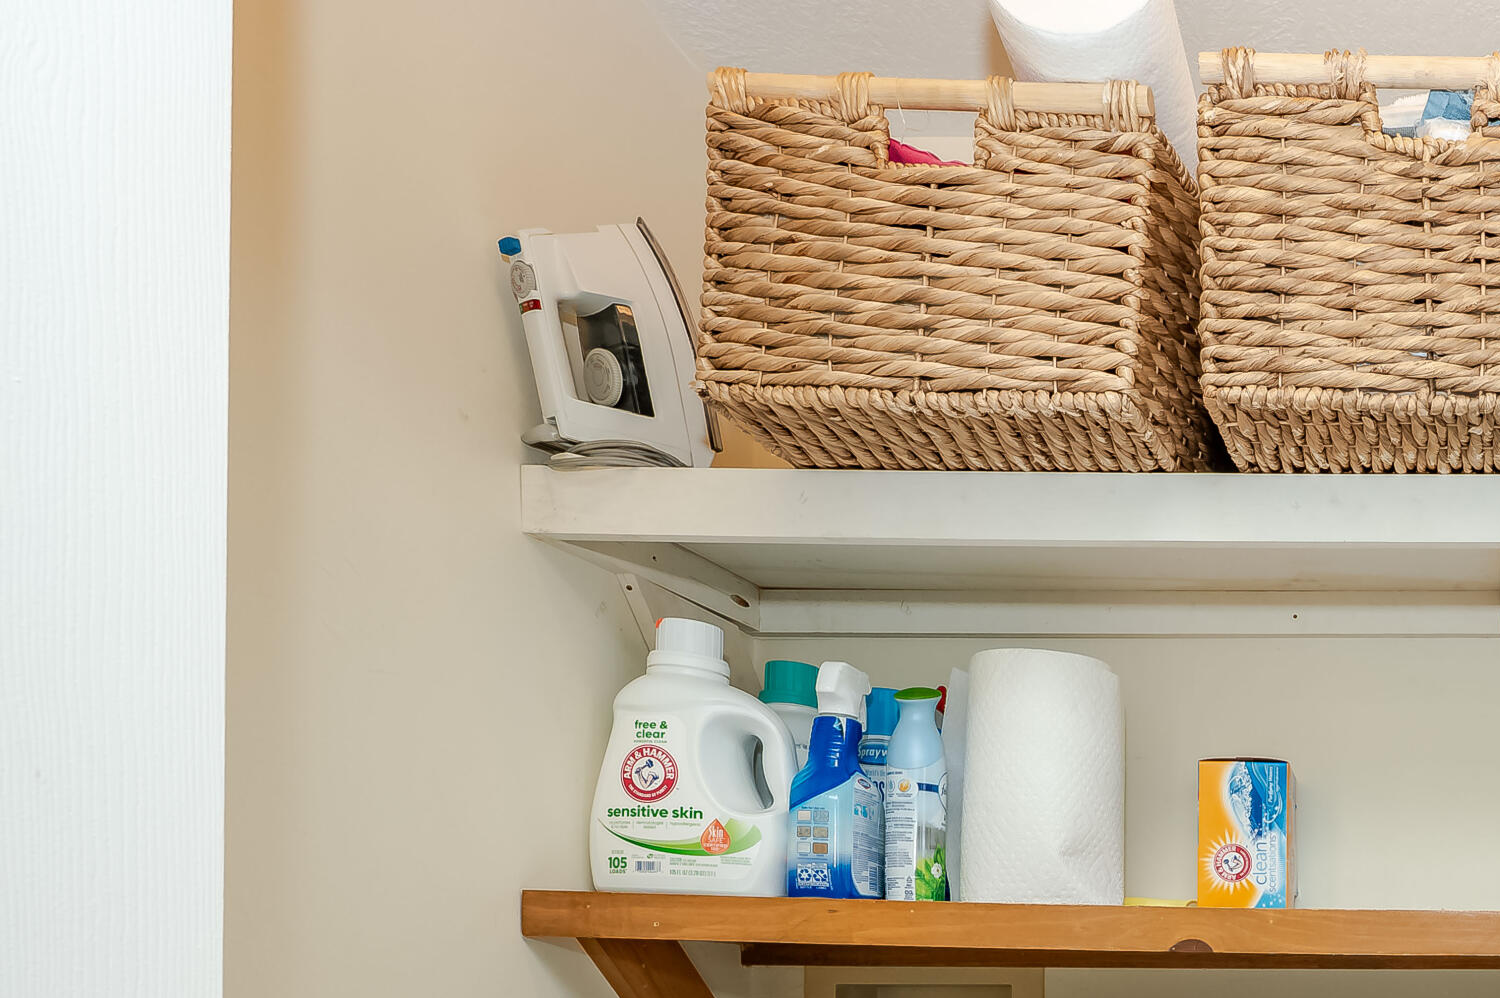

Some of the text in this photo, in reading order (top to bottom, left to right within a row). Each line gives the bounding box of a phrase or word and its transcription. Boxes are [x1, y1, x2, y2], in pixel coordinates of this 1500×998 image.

[634, 720, 668, 730] free &
[636, 729, 665, 739] clear
[624, 748, 675, 780] ARM & HAMMER
[607, 805, 704, 820] sensitive skin
[708, 825, 724, 840] Skin
[608, 856, 628, 869] 105
[1252, 842, 1267, 885] clean
[1268, 834, 1277, 893] scentsations
